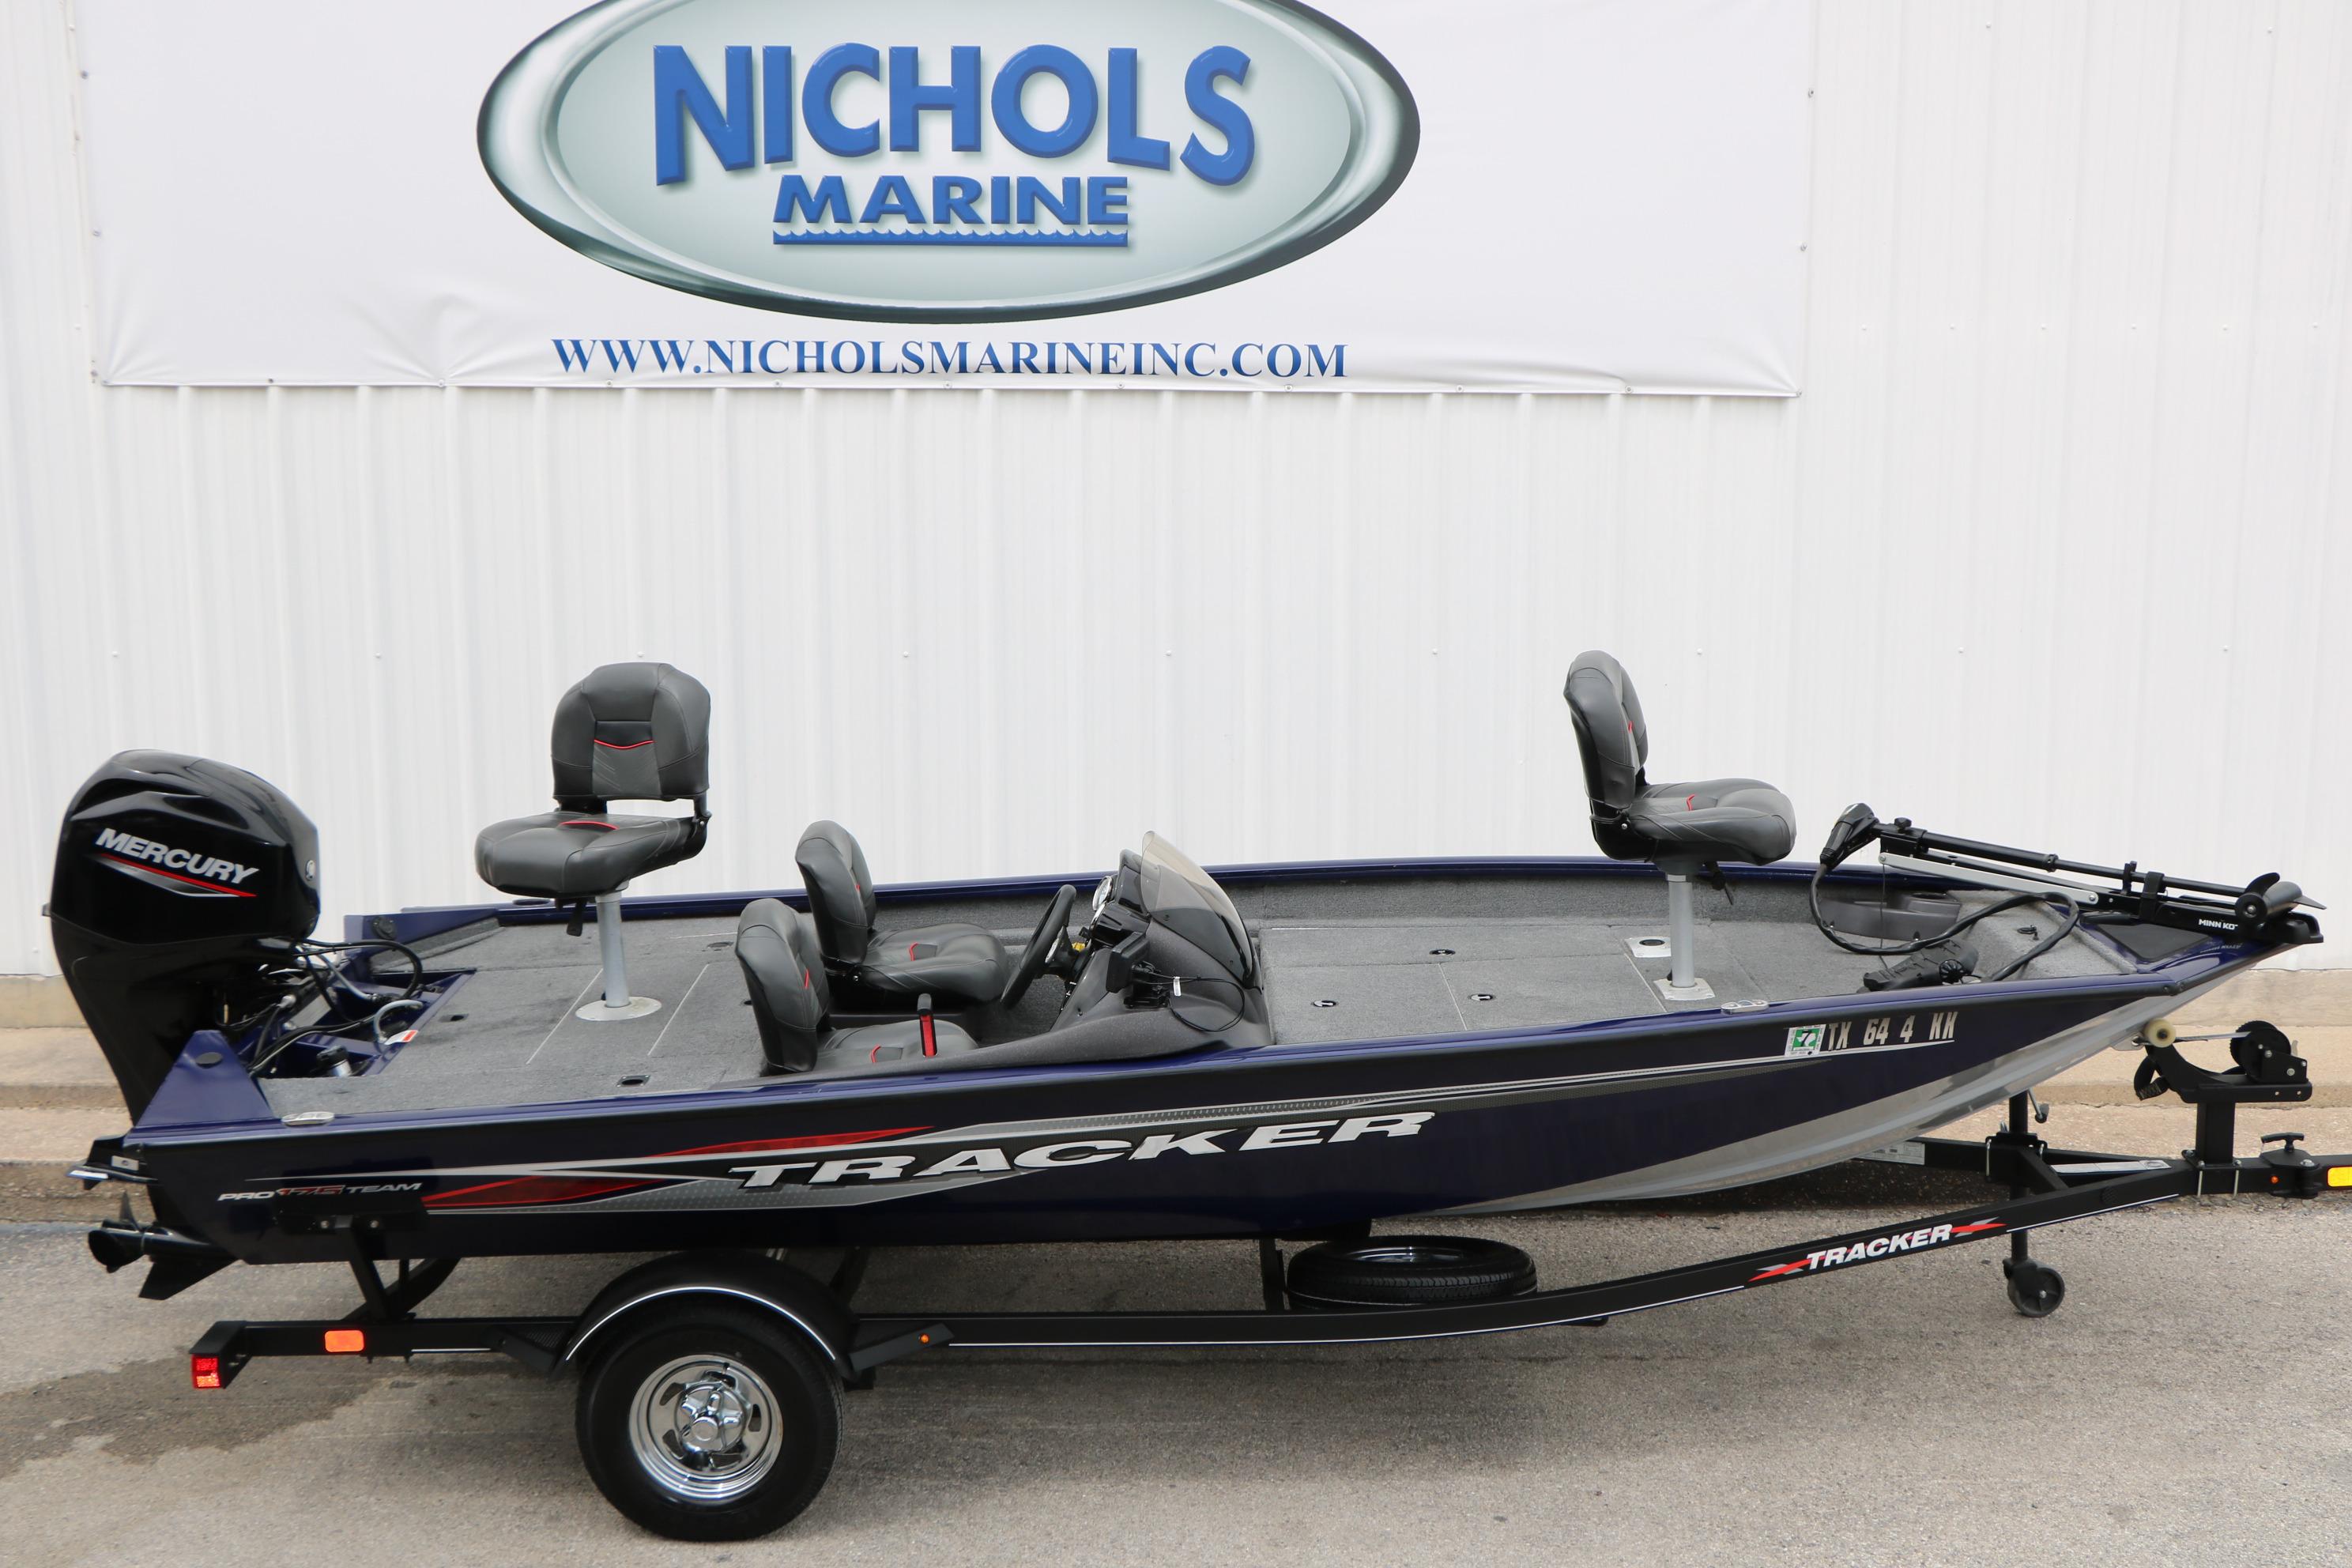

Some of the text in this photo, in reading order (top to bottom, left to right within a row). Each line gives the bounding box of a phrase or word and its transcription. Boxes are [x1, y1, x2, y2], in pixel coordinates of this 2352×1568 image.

[654, 43, 1255, 187] NICHOLS
[773, 175, 1129, 224] MARINE
[551, 338, 1348, 378] WWW.NICHOLSMARINEINC.COM
[96, 827, 259, 884] MERCURY
[2198, 918, 2222, 928] MINN
[1828, 1021, 1852, 1051] TX
[730, 1112, 1435, 1188] TRACKER
[217, 1191, 275, 1200] PRO
[345, 1182, 422, 1193] TEAM
[1807, 1224, 1952, 1270] TRACKER
